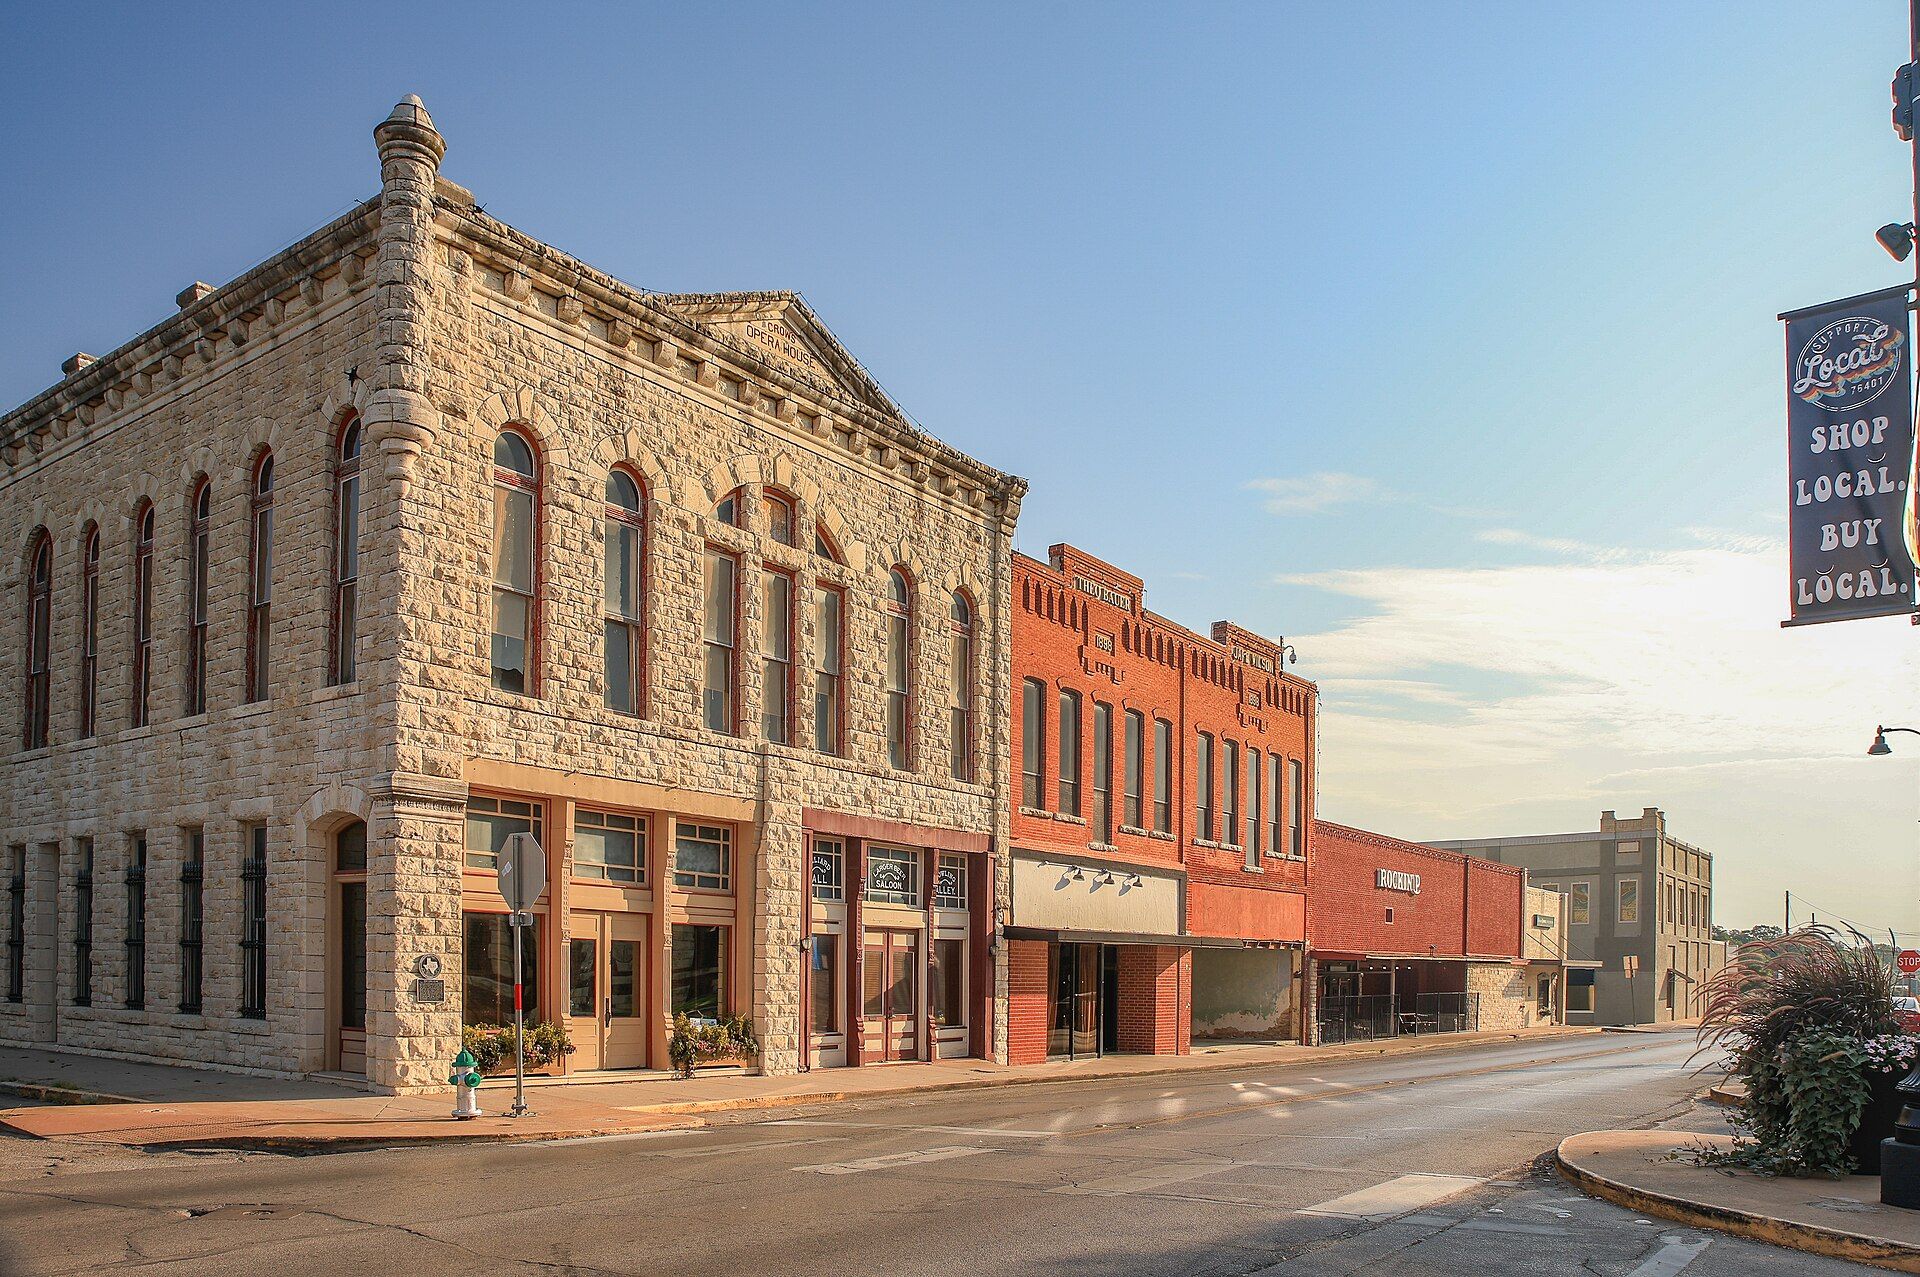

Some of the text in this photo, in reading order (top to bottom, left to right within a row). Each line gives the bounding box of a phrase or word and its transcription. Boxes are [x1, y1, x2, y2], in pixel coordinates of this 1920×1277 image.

[746, 324, 781, 352] OPERA
[1812, 323, 1869, 350] SUPPORT
[1793, 324, 1889, 394] Local
[1810, 416, 1889, 454] SHOP
[1796, 466, 1906, 506] LOCAL.
[1820, 518, 1882, 552] BUY
[1103, 590, 1131, 611] BAUER
[1797, 567, 1908, 606] LOCAL.
[812, 874, 828, 884] ALL
[1898, 957, 1920, 966] STOP
